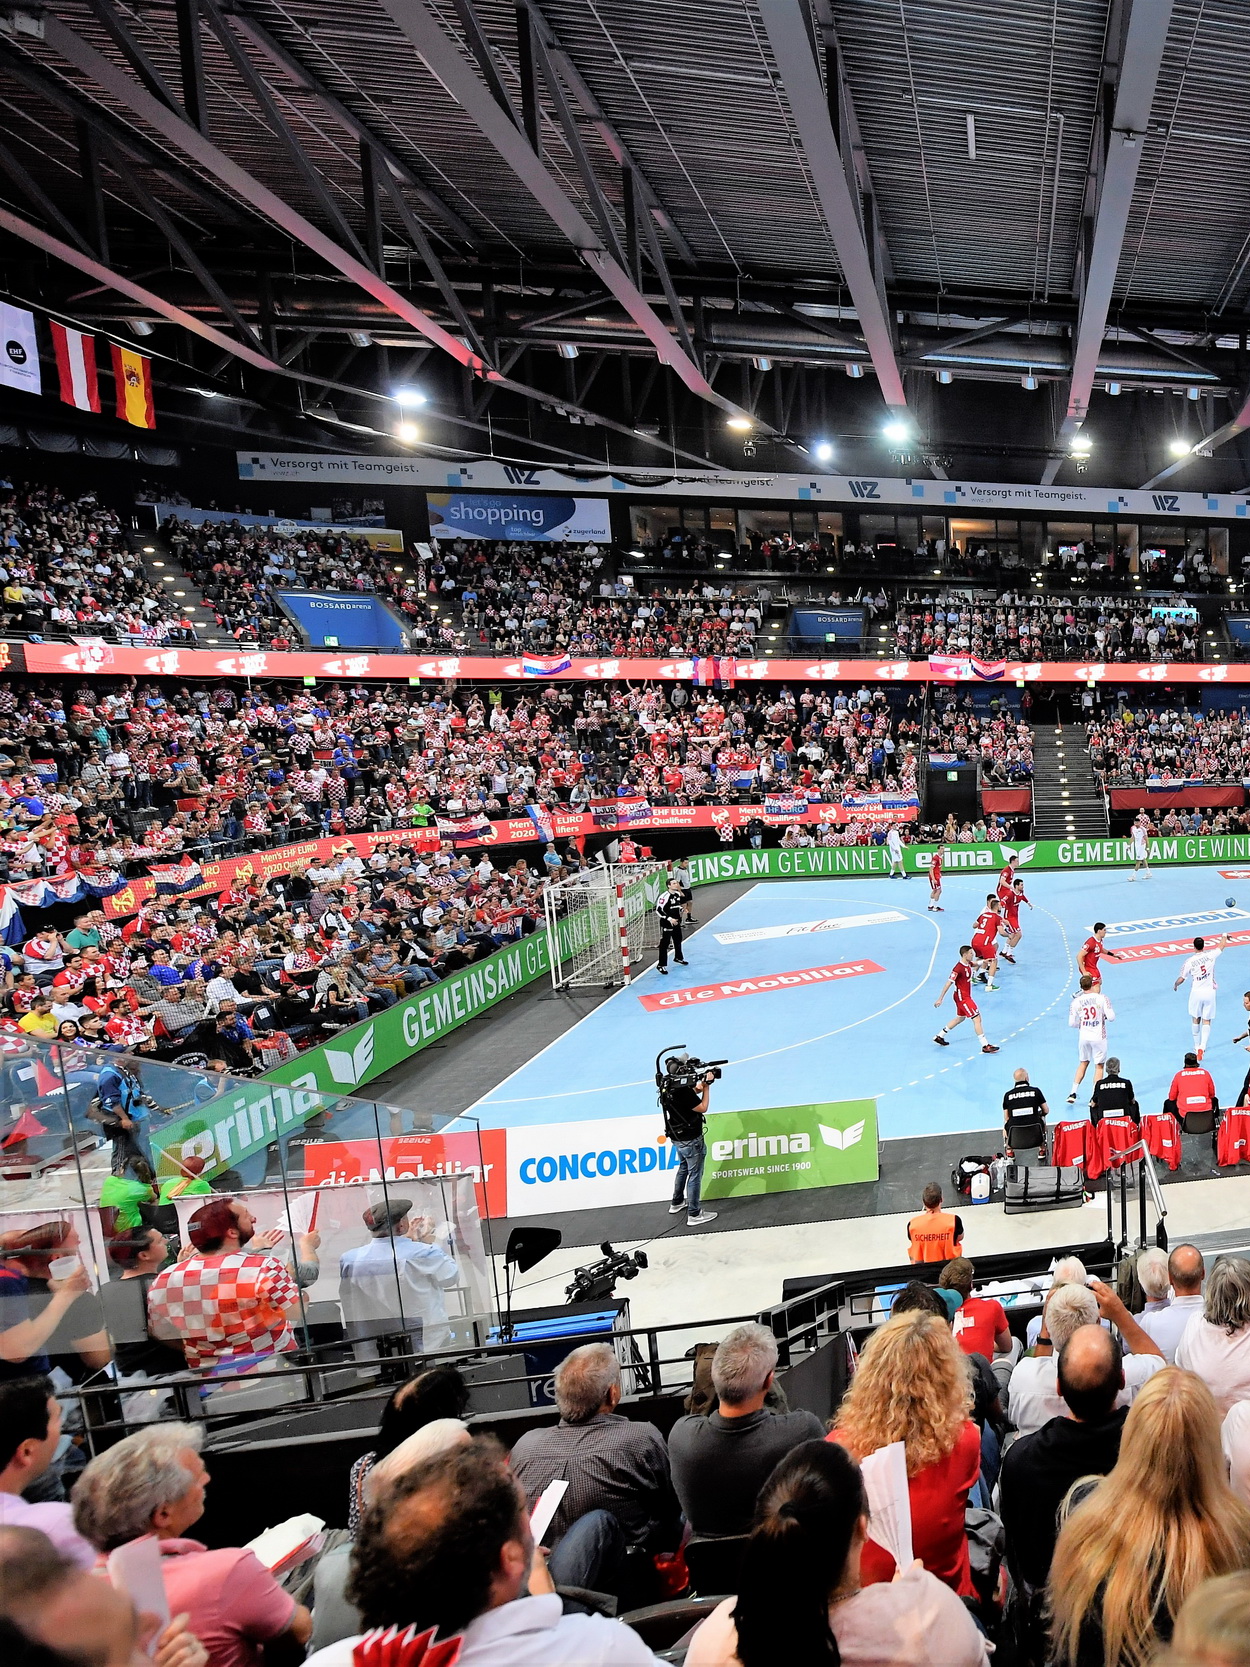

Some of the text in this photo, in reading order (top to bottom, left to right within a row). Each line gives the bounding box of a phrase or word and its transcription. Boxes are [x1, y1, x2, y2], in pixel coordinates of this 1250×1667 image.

[270, 458, 420, 474] Versorgt mit Teamgeist.
[970, 486, 1087, 502] Versorgt mit Teamgeist.
[450, 502, 545, 526] shopping
[671, 808, 696, 816] EURO
[738, 807, 763, 815] Men's
[781, 806, 805, 814] EURO
[556, 815, 584, 825] EURO
[628, 817, 692, 826] 2020 Qualifiers
[763, 814, 801, 822] Qualifiers
[367, 828, 424, 843] Men's EHF
[510, 828, 535, 838] 2020
[261, 843, 318, 864] Men's EHF EURO
[1058, 840, 1179, 863] GEMEINAM
[262, 862, 285, 876] 2020
[980, 917, 988, 928] 3
[1105, 909, 1246, 935] CONCORDIA
[1117, 949, 1155, 961] die
[1200, 964, 1207, 976] 5
[659, 964, 866, 1006] die Mobiliar
[402, 949, 523, 1047] GEMEINSAM
[1083, 1006, 1097, 1020] 39
[1100, 1082, 1126, 1090] SUISSE
[1009, 1090, 1035, 1100] SUISSE
[182, 1070, 322, 1174] erima
[711, 1131, 811, 1162] erima
[519, 1136, 681, 1185] CONCORDIA
[711, 1161, 811, 1179] SPORTSWEAR SINCE 1900
[914, 1232, 950, 1242] SICHERHEIT
